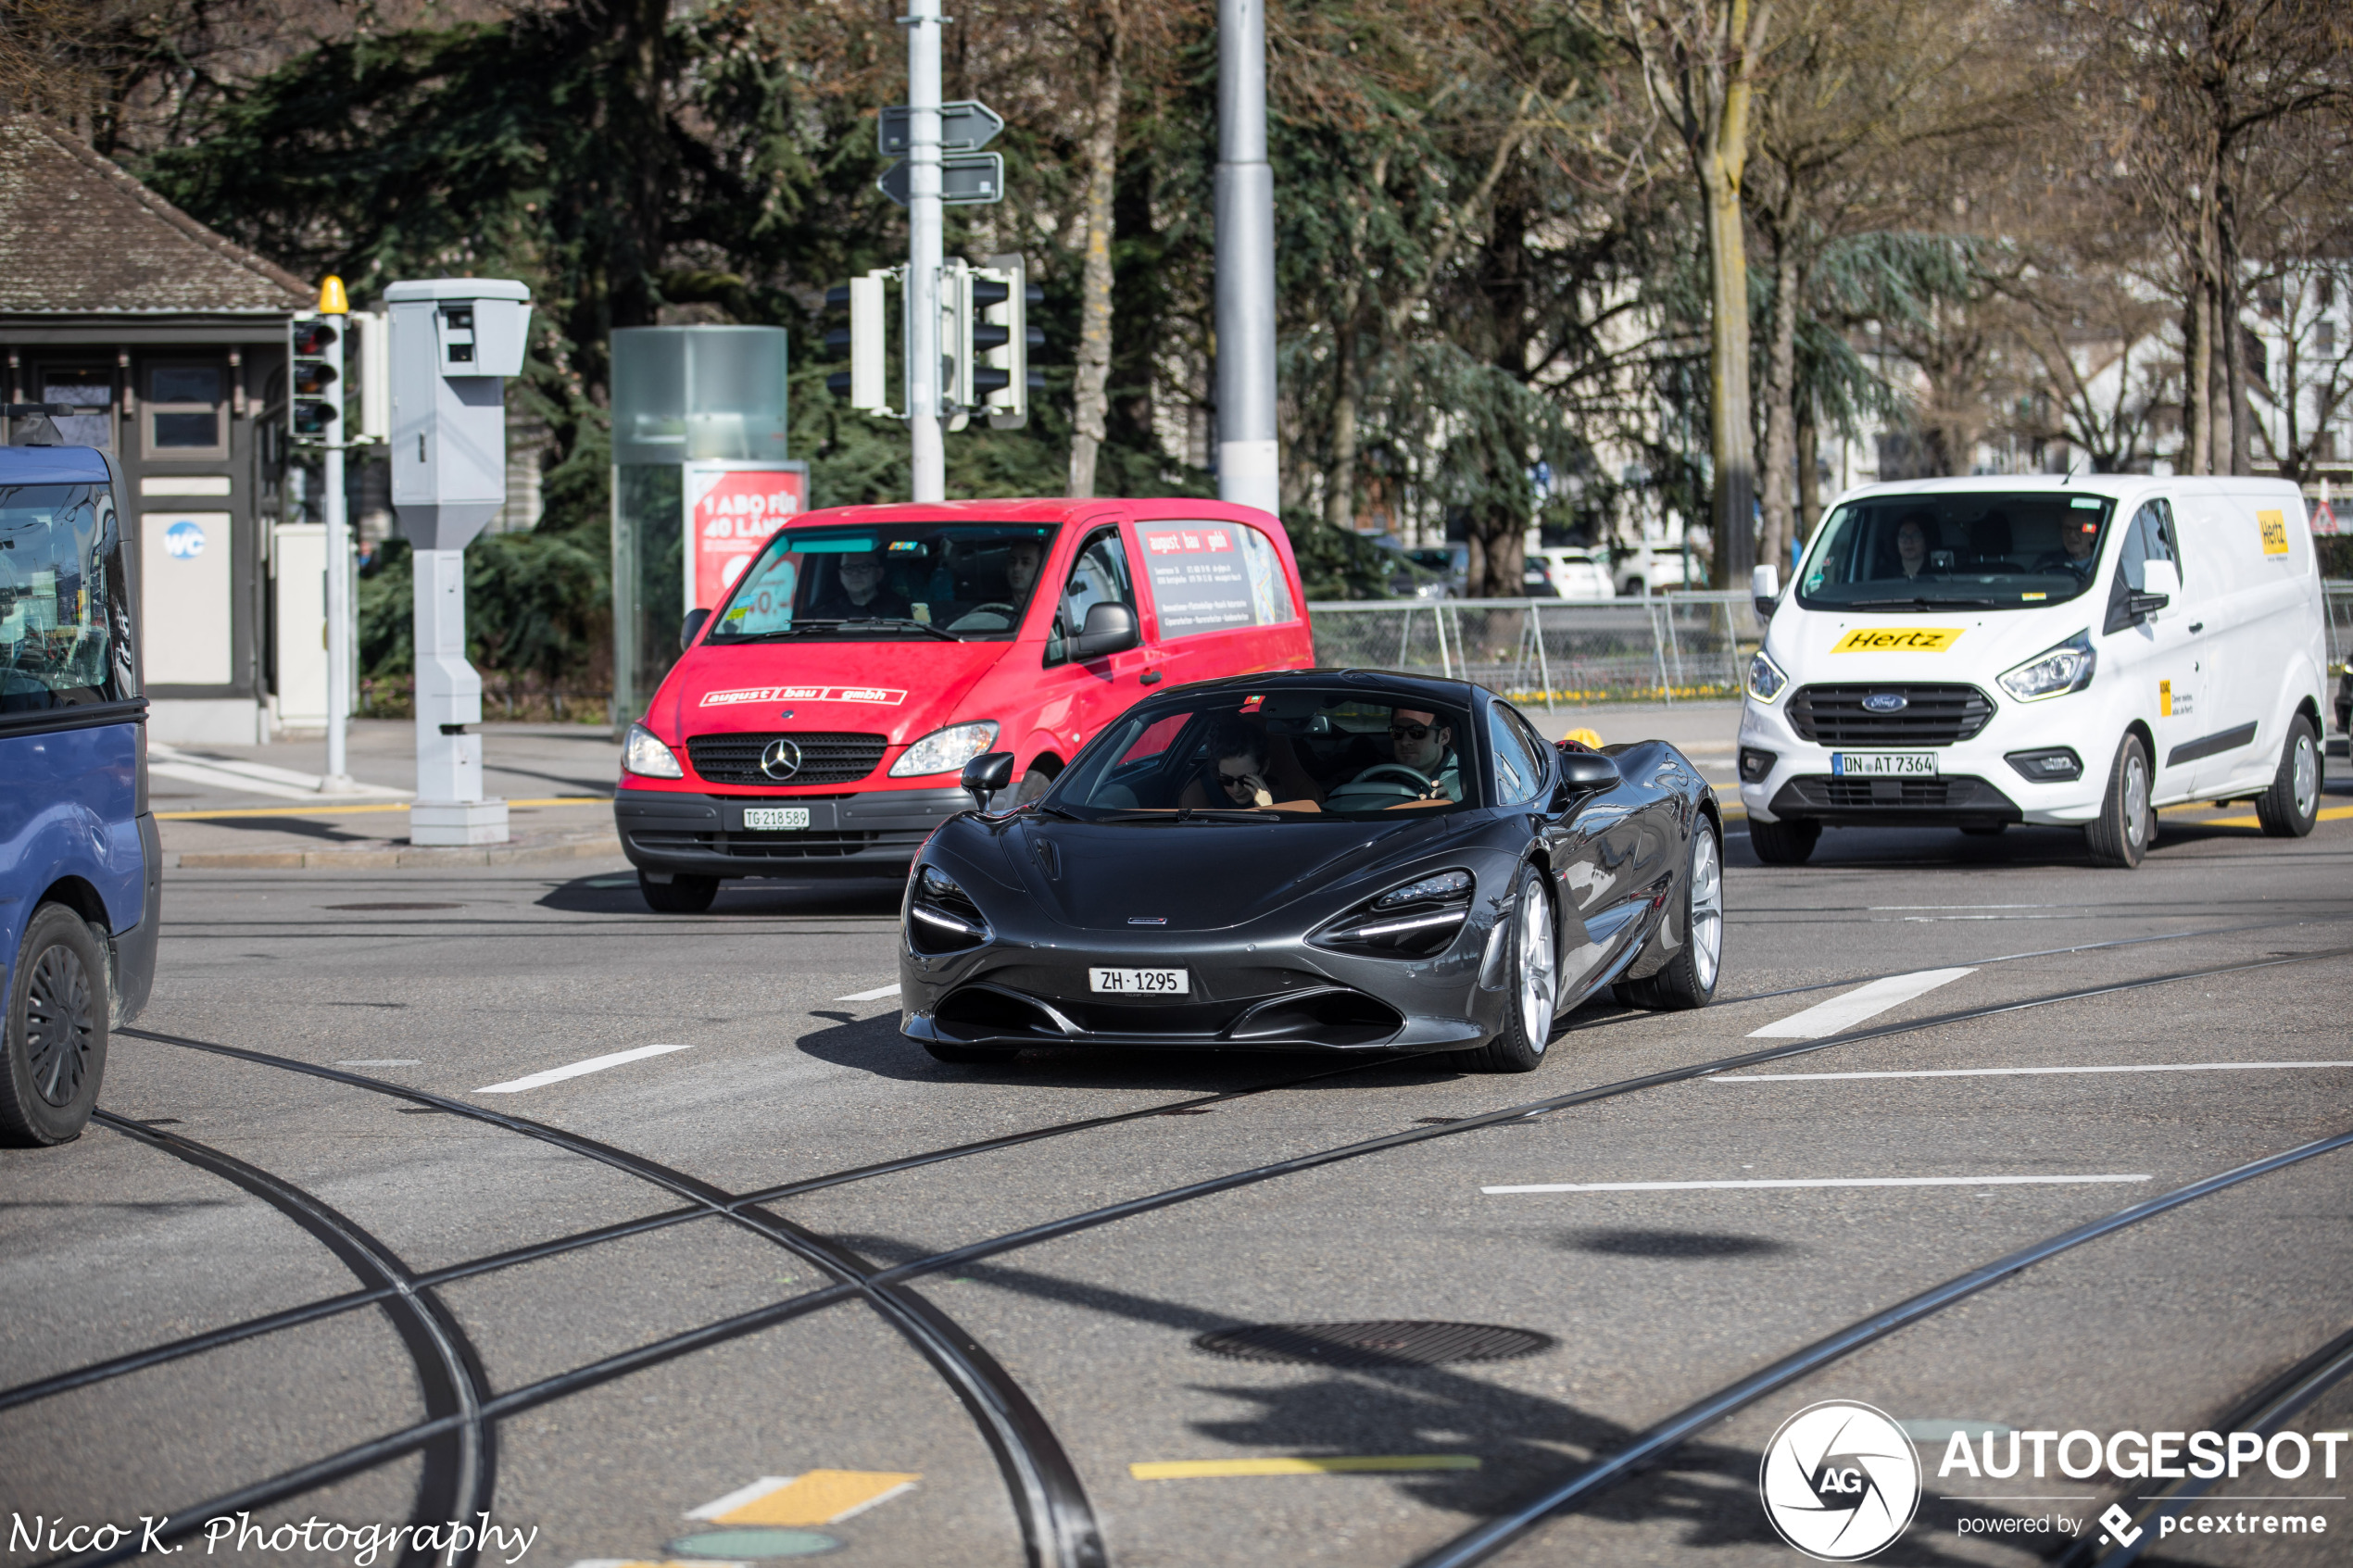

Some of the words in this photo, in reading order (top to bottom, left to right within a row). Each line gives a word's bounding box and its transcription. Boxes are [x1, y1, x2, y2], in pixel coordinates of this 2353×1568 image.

[717, 495, 765, 515] ABO
[768, 491, 798, 515] FÜR
[704, 517, 732, 537] 40
[2260, 519, 2285, 546] Hertz
[164, 533, 207, 557] WC
[1150, 534, 1181, 554] august
[1182, 532, 1201, 549] bau
[1847, 631, 1944, 648] Hertz
[708, 688, 770, 703] august
[783, 688, 816, 698] bau
[841, 689, 887, 700] gmbh
[1870, 696, 1896, 708] Ford
[1844, 757, 1862, 773] DN
[1874, 757, 1891, 772] AT
[1896, 756, 1932, 772] 7364
